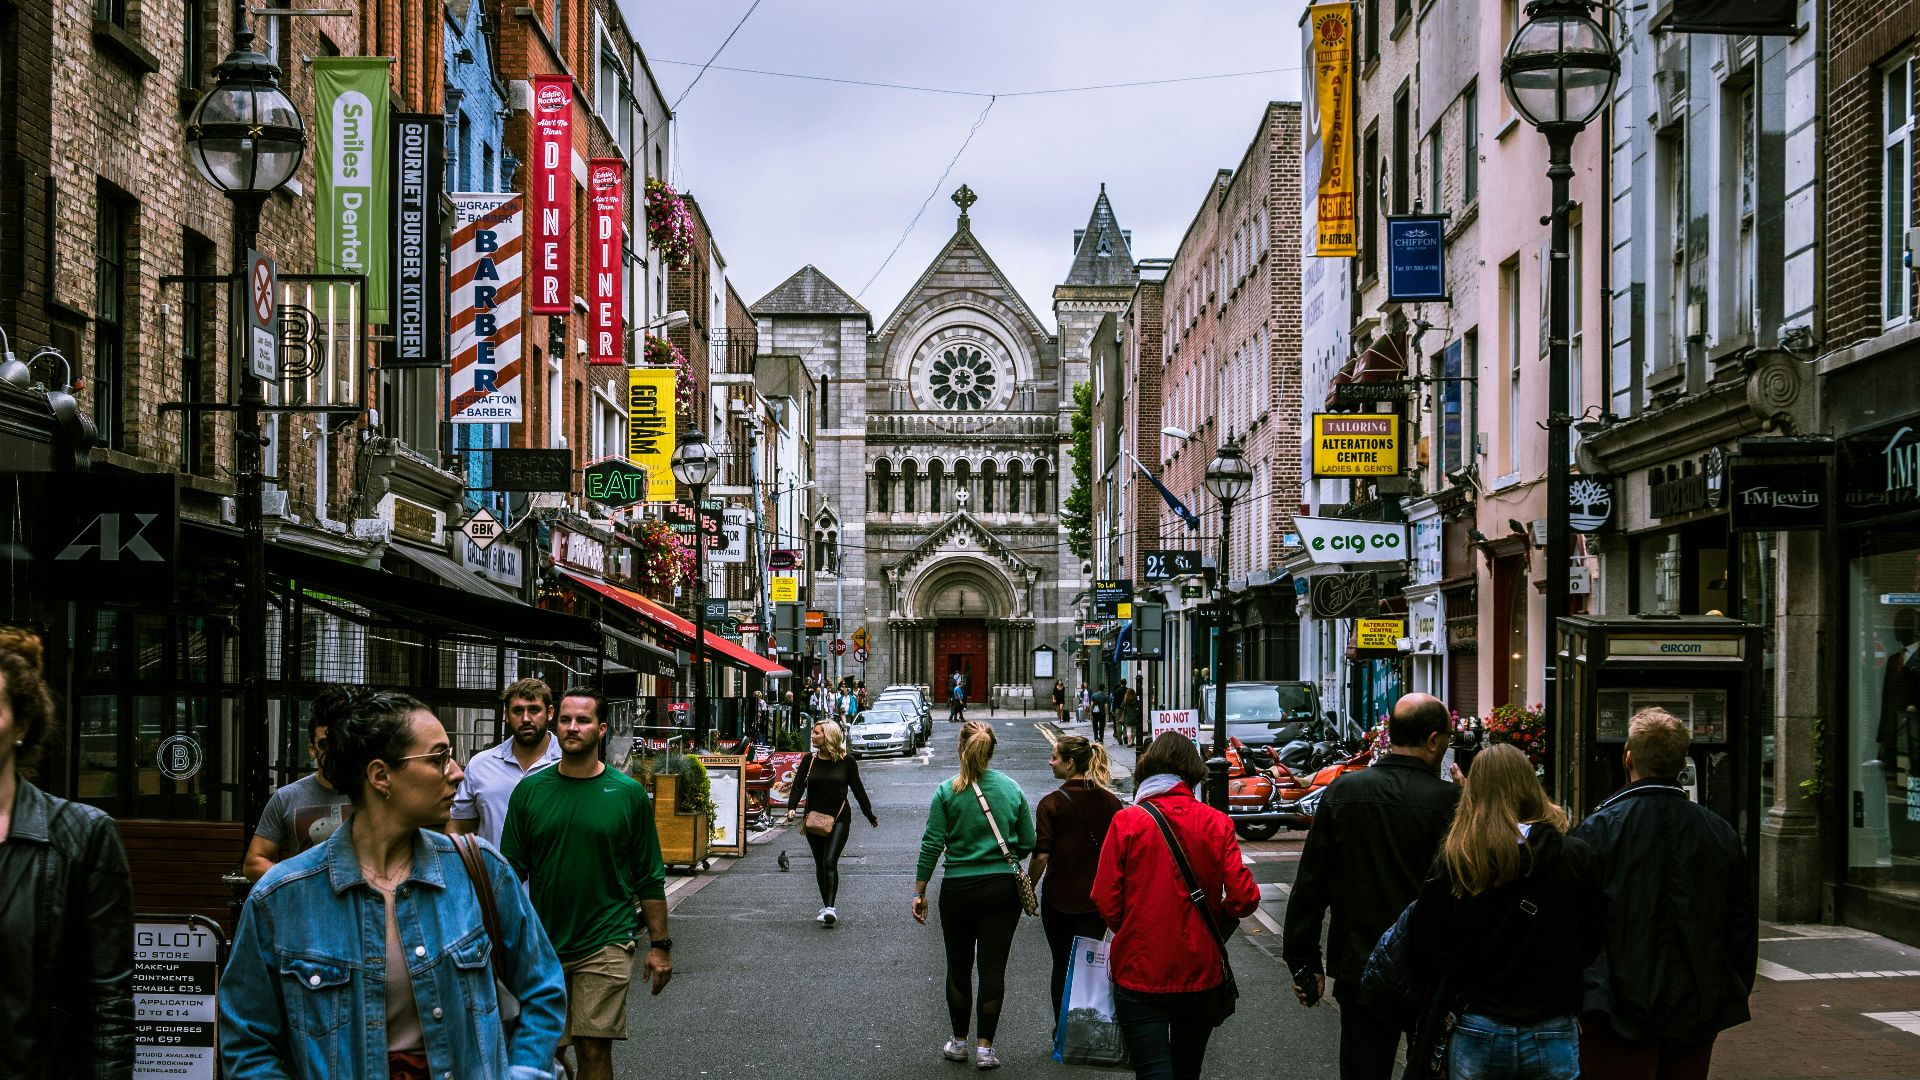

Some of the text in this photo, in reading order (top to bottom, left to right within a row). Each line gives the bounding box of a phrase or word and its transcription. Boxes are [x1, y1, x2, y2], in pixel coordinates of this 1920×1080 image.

[1330, 74, 1342, 188] ALTERATION
[342, 103, 364, 269] Smiles Dental
[457, 201, 466, 222] THE
[466, 201, 518, 211] GRAFTON
[1320, 196, 1352, 218] CENTRE
[468, 214, 513, 224] BARBER
[543, 140, 560, 305] DINER
[403, 123, 423, 358] GOURMET BURGER KITCHEN
[1394, 238, 1437, 247] CHIFFON
[599, 215, 614, 356] DINER
[474, 229, 500, 393] BARBER
[1340, 384, 1404, 399] RESTAURANT
[466, 395, 517, 405] GRAFTON
[467, 408, 512, 417] BARBER
[631, 385, 668, 455] GOTHAM
[1327, 422, 1387, 432] TAILORING
[1322, 439, 1394, 449] ALTERATIONS
[1337, 452, 1378, 462] CENTRE
[1363, 465, 1393, 473] GENTS
[588, 470, 642, 498] EAT
[472, 523, 494, 534] GBK
[54, 513, 166, 562] AK
[1312, 536, 1325, 550] e
[1330, 534, 1366, 553] cig
[1371, 533, 1400, 548] co
[467, 540, 493, 570] GALLERY
[492, 551, 498, 571] @
[507, 553, 517, 577] SIX
[1146, 555, 1169, 577] 22
[1160, 712, 1189, 723] DO NOT
[1177, 727, 1197, 738] THIS
[172, 745, 190, 771] B
[138, 932, 207, 947] GLOT
[152, 951, 190, 959] STORE
[179, 985, 202, 993] €35
[166, 1009, 190, 1017] €14
[156, 1025, 202, 1033] COURSES
[158, 1036, 181, 1044] €99
